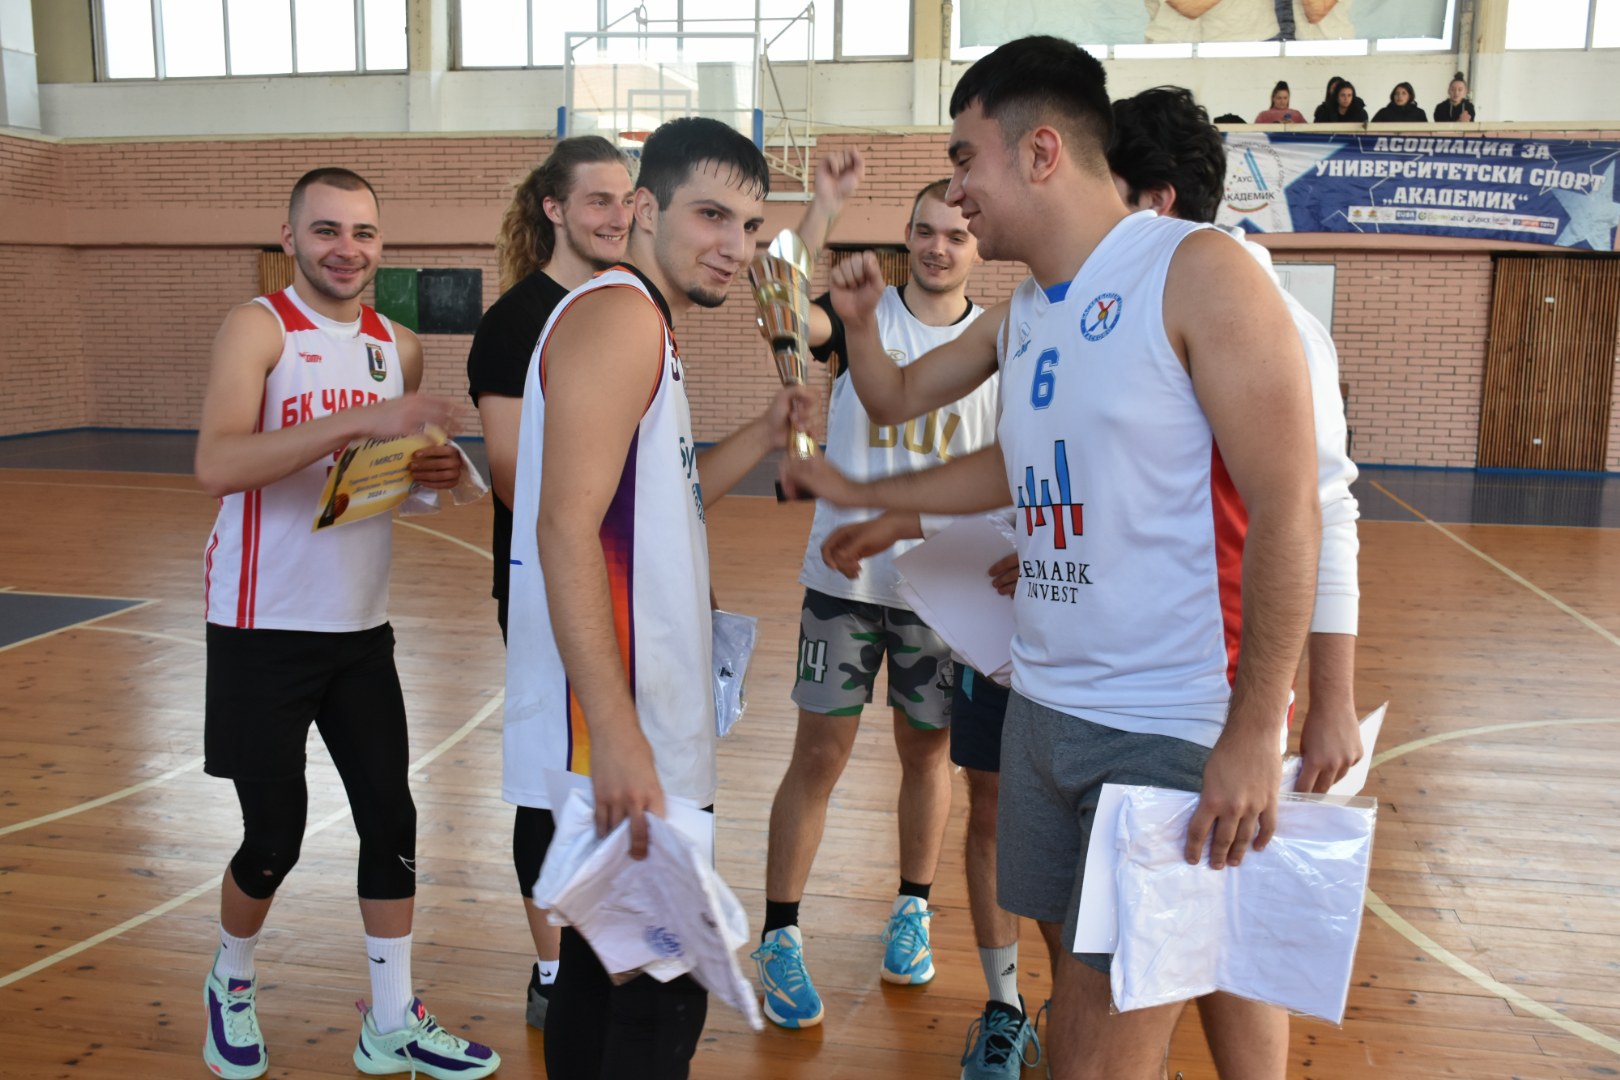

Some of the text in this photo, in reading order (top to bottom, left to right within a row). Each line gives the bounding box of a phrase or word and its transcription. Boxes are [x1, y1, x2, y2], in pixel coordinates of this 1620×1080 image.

[1373, 136, 1550, 160] АСОЦИАЦИЯ ЗА
[1237, 175, 1253, 183] АУС
[1315, 159, 1606, 192] УНИВЕРСИТЕТСКИ СПОРТ
[1029, 346, 1060, 411] 6
[281, 391, 314, 430] БК
[1018, 559, 1094, 585] EMARK
[1027, 581, 1079, 604] INVEST
[800, 637, 828, 684] 14
